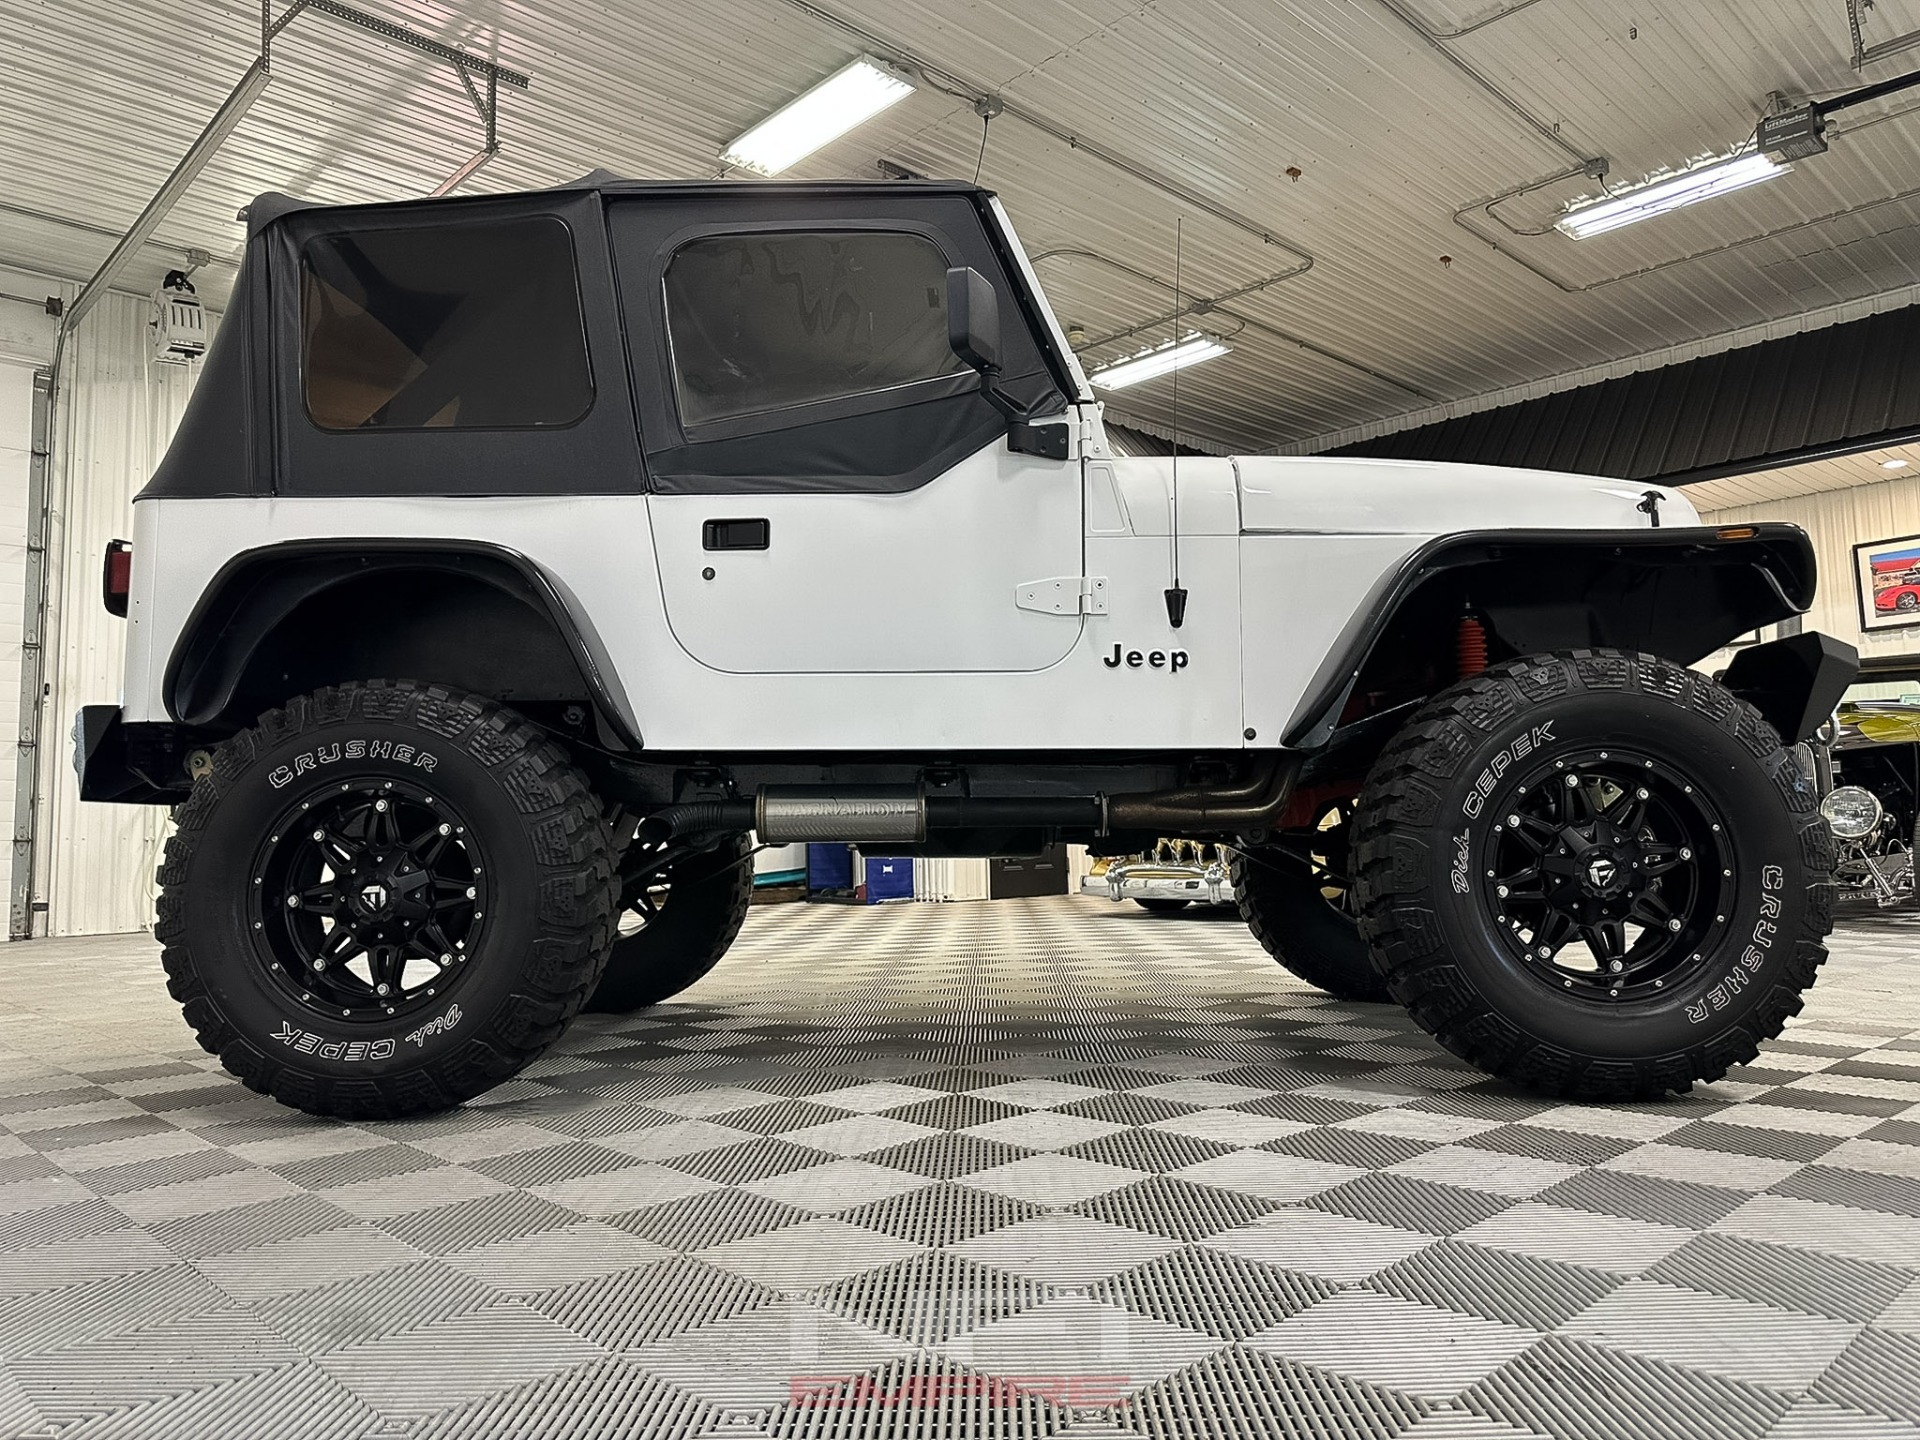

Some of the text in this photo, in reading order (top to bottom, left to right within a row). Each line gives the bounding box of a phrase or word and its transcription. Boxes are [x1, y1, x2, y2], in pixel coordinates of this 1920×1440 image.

[1103, 644, 1189, 673] Jeep
[268, 740, 438, 788] CRUSHER
[1451, 719, 1556, 893] Dick CEPEK
[1684, 865, 1784, 1024] CRUSHER
[269, 1003, 463, 1061] Dick CEPEK
